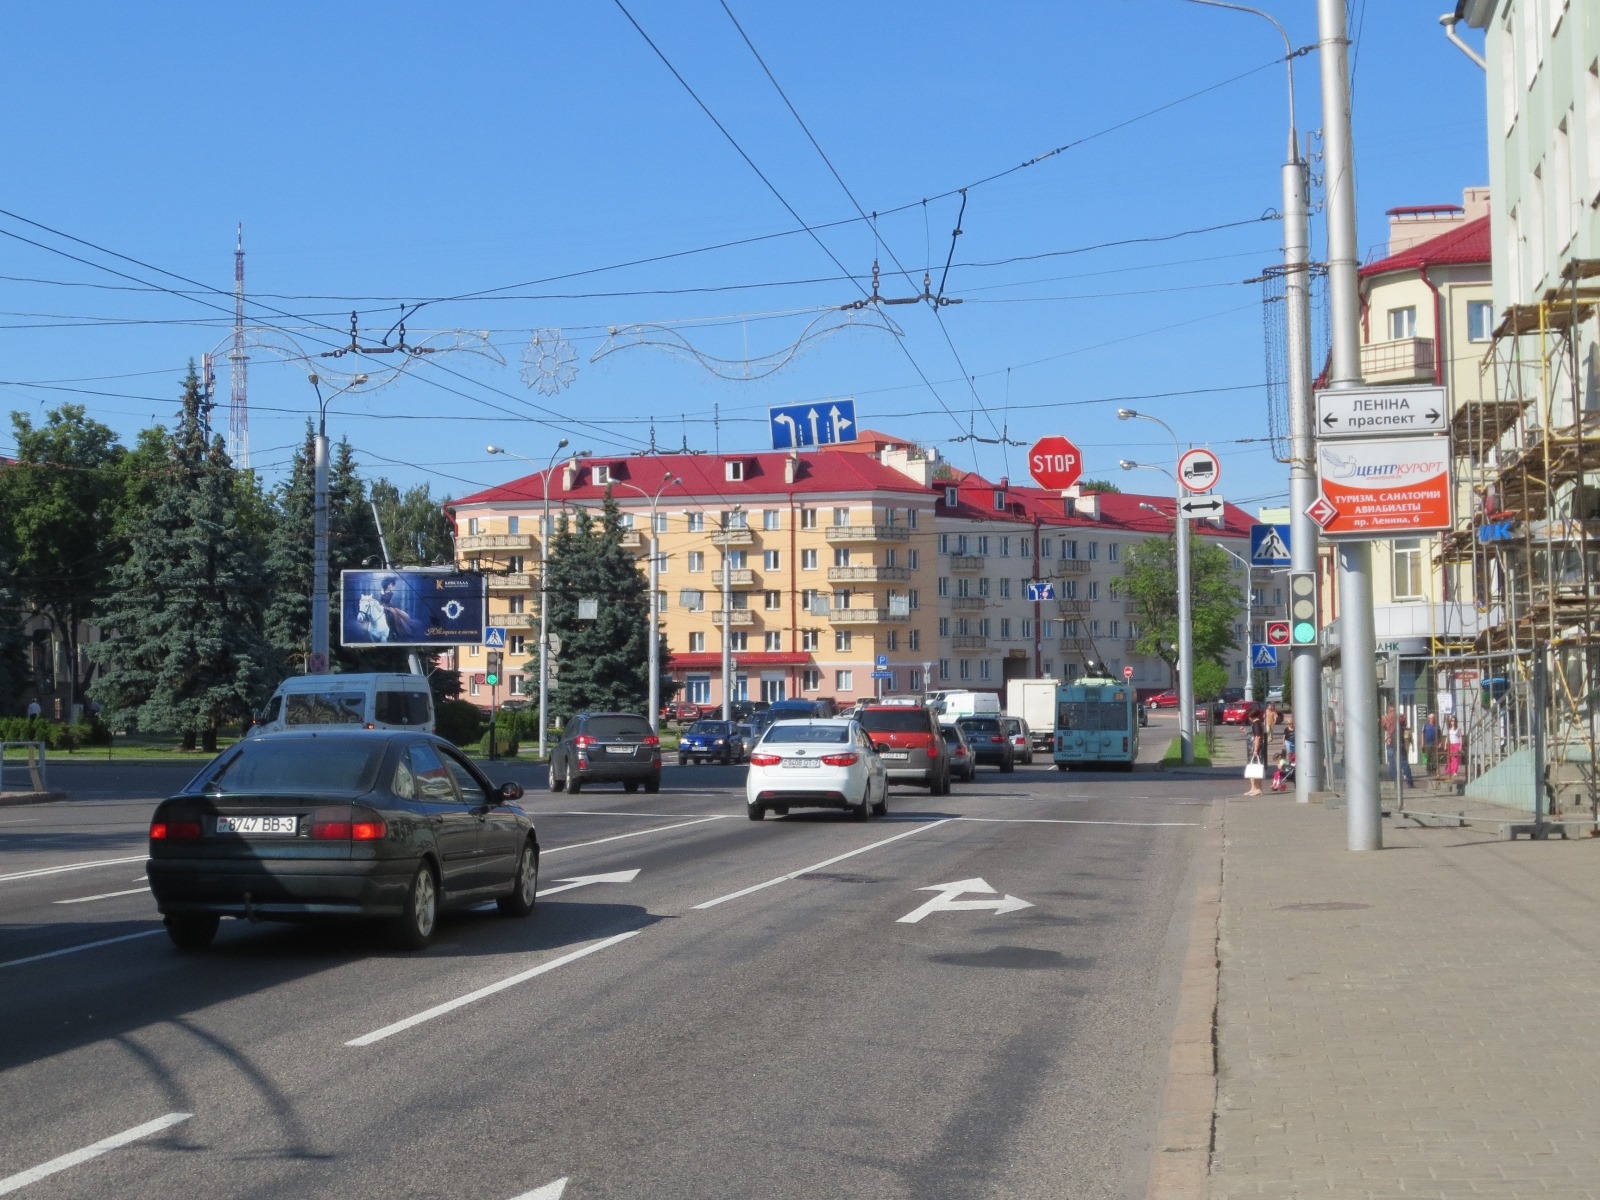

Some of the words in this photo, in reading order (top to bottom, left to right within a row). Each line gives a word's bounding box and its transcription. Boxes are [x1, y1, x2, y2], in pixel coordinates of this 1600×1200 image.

[1353, 398, 1410, 411] ЛЕНІНА
[1348, 415, 1416, 428] праспект
[1033, 454, 1075, 473] STOP
[1356, 461, 1443, 477] ЦЕНТРКУРОРТ
[1335, 494, 1377, 503] ТУРИЗМ,
[1379, 490, 1441, 501] САНАТОРИИ
[1354, 503, 1421, 514] АВИАБИЛЕТЫ
[1354, 518, 1369, 527] пр.
[1371, 516, 1411, 525] Ленина,
[1413, 514, 1420, 522] 6
[229, 818, 259, 832] 8747
[262, 818, 294, 832] BB-3
